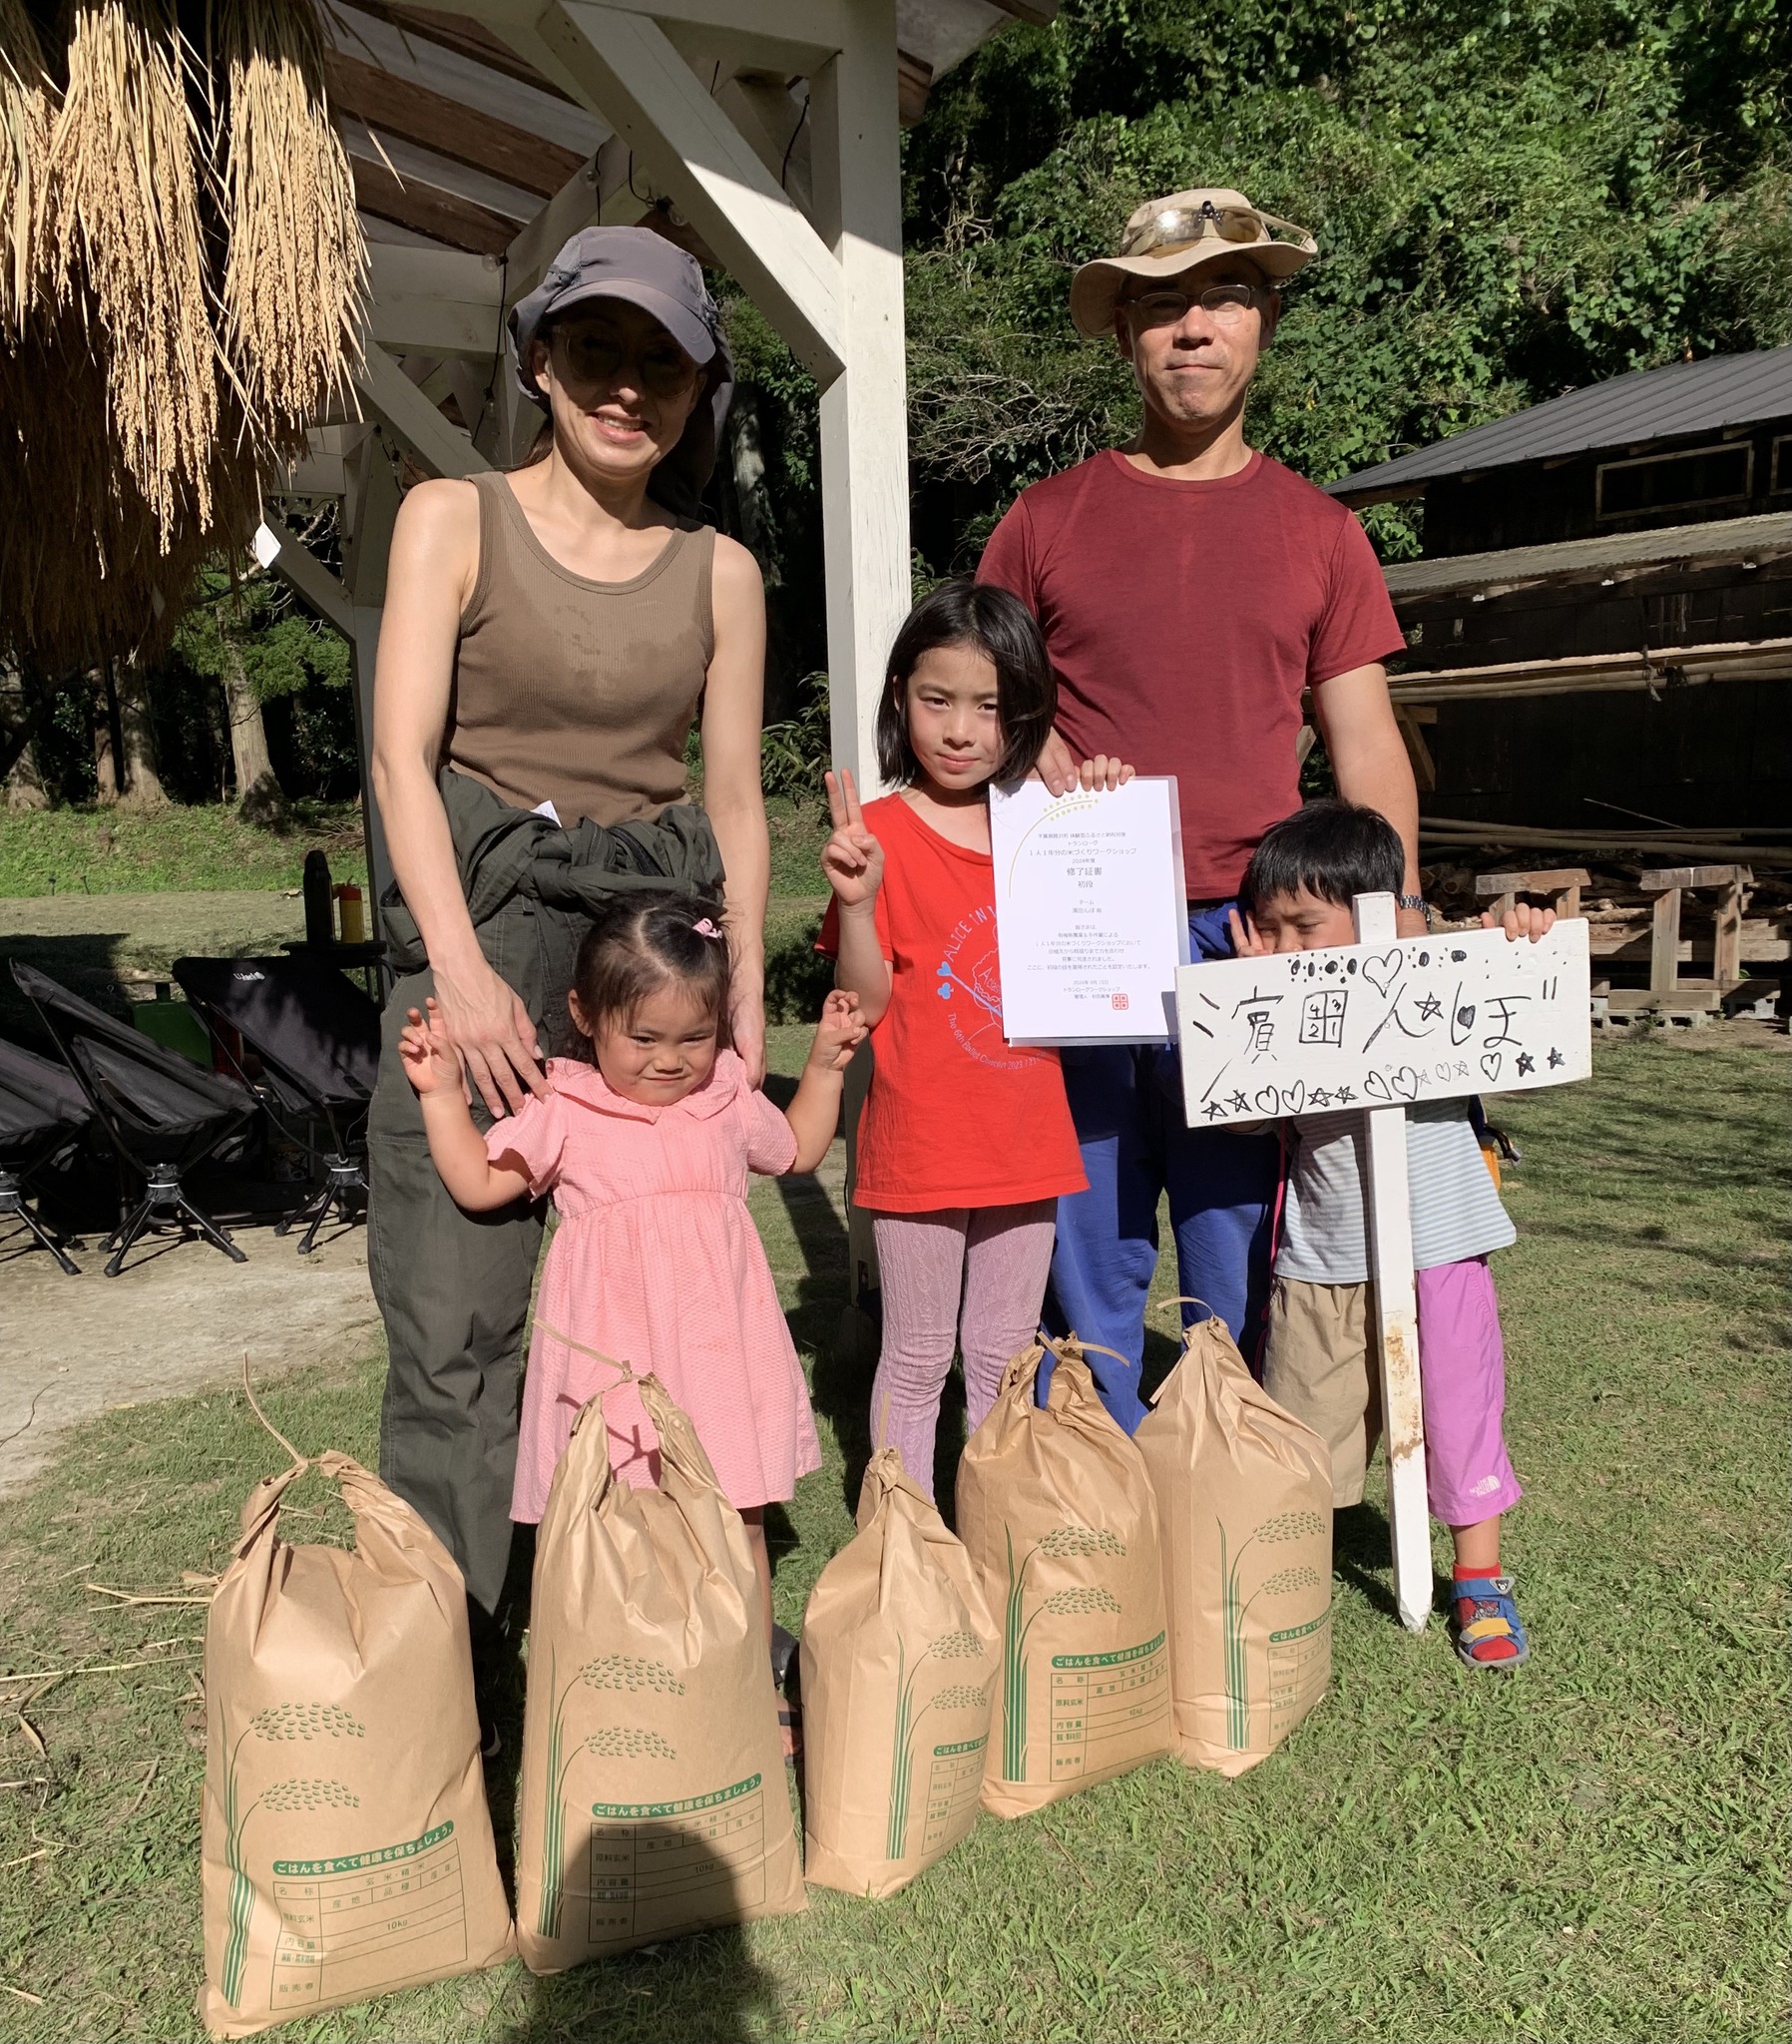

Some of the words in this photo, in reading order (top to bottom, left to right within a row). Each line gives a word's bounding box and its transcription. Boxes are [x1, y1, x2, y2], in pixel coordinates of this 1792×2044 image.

[1067, 866, 1103, 876] 修了証書
[943, 920, 973, 962] ALICE
[694, 1861, 714, 1874] 10kg
[278, 1885, 314, 1896] 名称
[386, 1918, 408, 1931] 10kg
